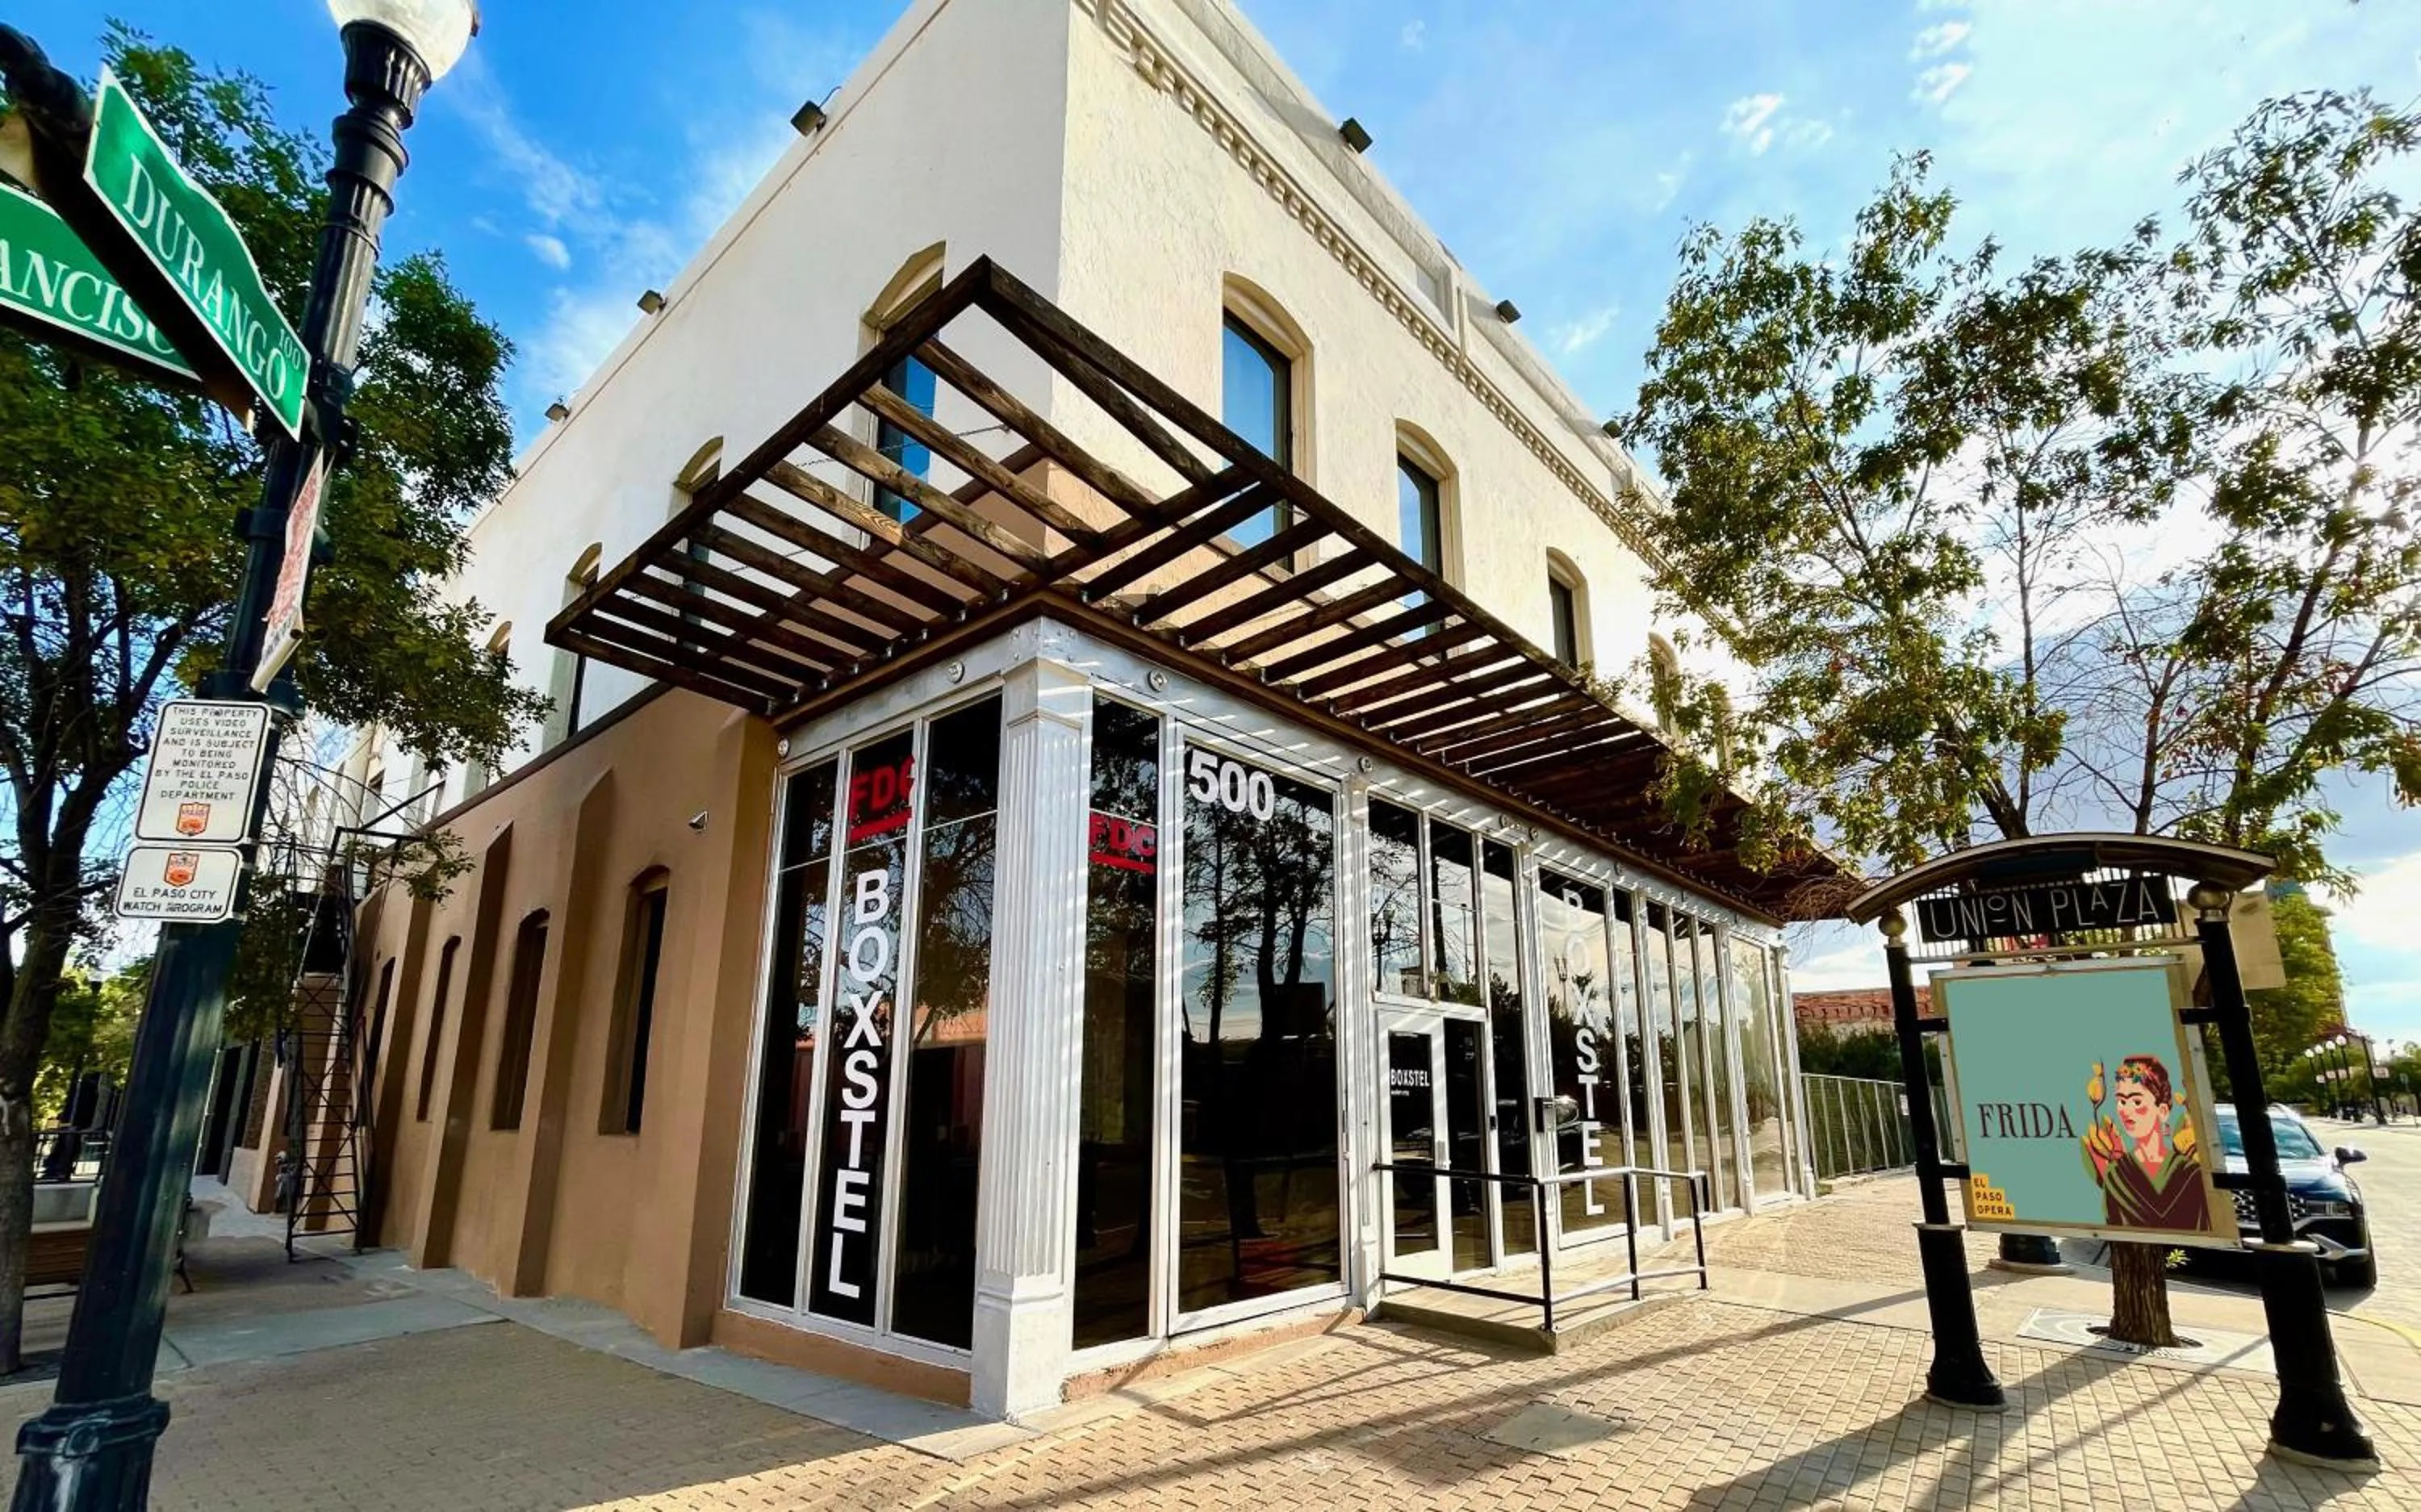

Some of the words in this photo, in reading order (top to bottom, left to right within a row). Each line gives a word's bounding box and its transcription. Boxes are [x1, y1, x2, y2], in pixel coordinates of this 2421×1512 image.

[123, 153, 286, 400] DURANGO
[279, 328, 301, 370] 100
[173, 707, 196, 716] THIS
[202, 708, 257, 718] PROPERTY
[181, 717, 209, 725] USES
[215, 719, 246, 727] VIDEO
[169, 727, 252, 737] SURVEILLANCE
[163, 737, 186, 746] AND
[190, 738, 201, 746] IS
[206, 739, 256, 749] SUBJECT
[182, 749, 195, 758] TO
[200, 750, 232, 758] BEING
[173, 759, 236, 769] MONITORED
[155, 769, 169, 777] BY
[176, 770, 194, 779] THE
[200, 771, 213, 779] EL
[218, 771, 249, 780] PASO
[180, 780, 220, 790] POLICE
[1189, 747, 1274, 822] 500
[161, 791, 236, 800] DEPARTMENT
[133, 888, 147, 897] EL
[151, 888, 186, 898] PASO
[190, 890, 217, 900] CITY
[123, 901, 161, 912] WATCH
[1930, 892, 2034, 938] UNION
[2050, 879, 2160, 929] PLAZA
[1390, 1067, 1430, 1087] BOXSTEL
[828, 868, 890, 1299] BOXSTEL
[1976, 1103, 2078, 1138] FRIDA
[1974, 1177, 1987, 1188] EL
[1976, 1192, 2003, 1201] PASO
[1976, 1205, 2013, 1216] OPERA
